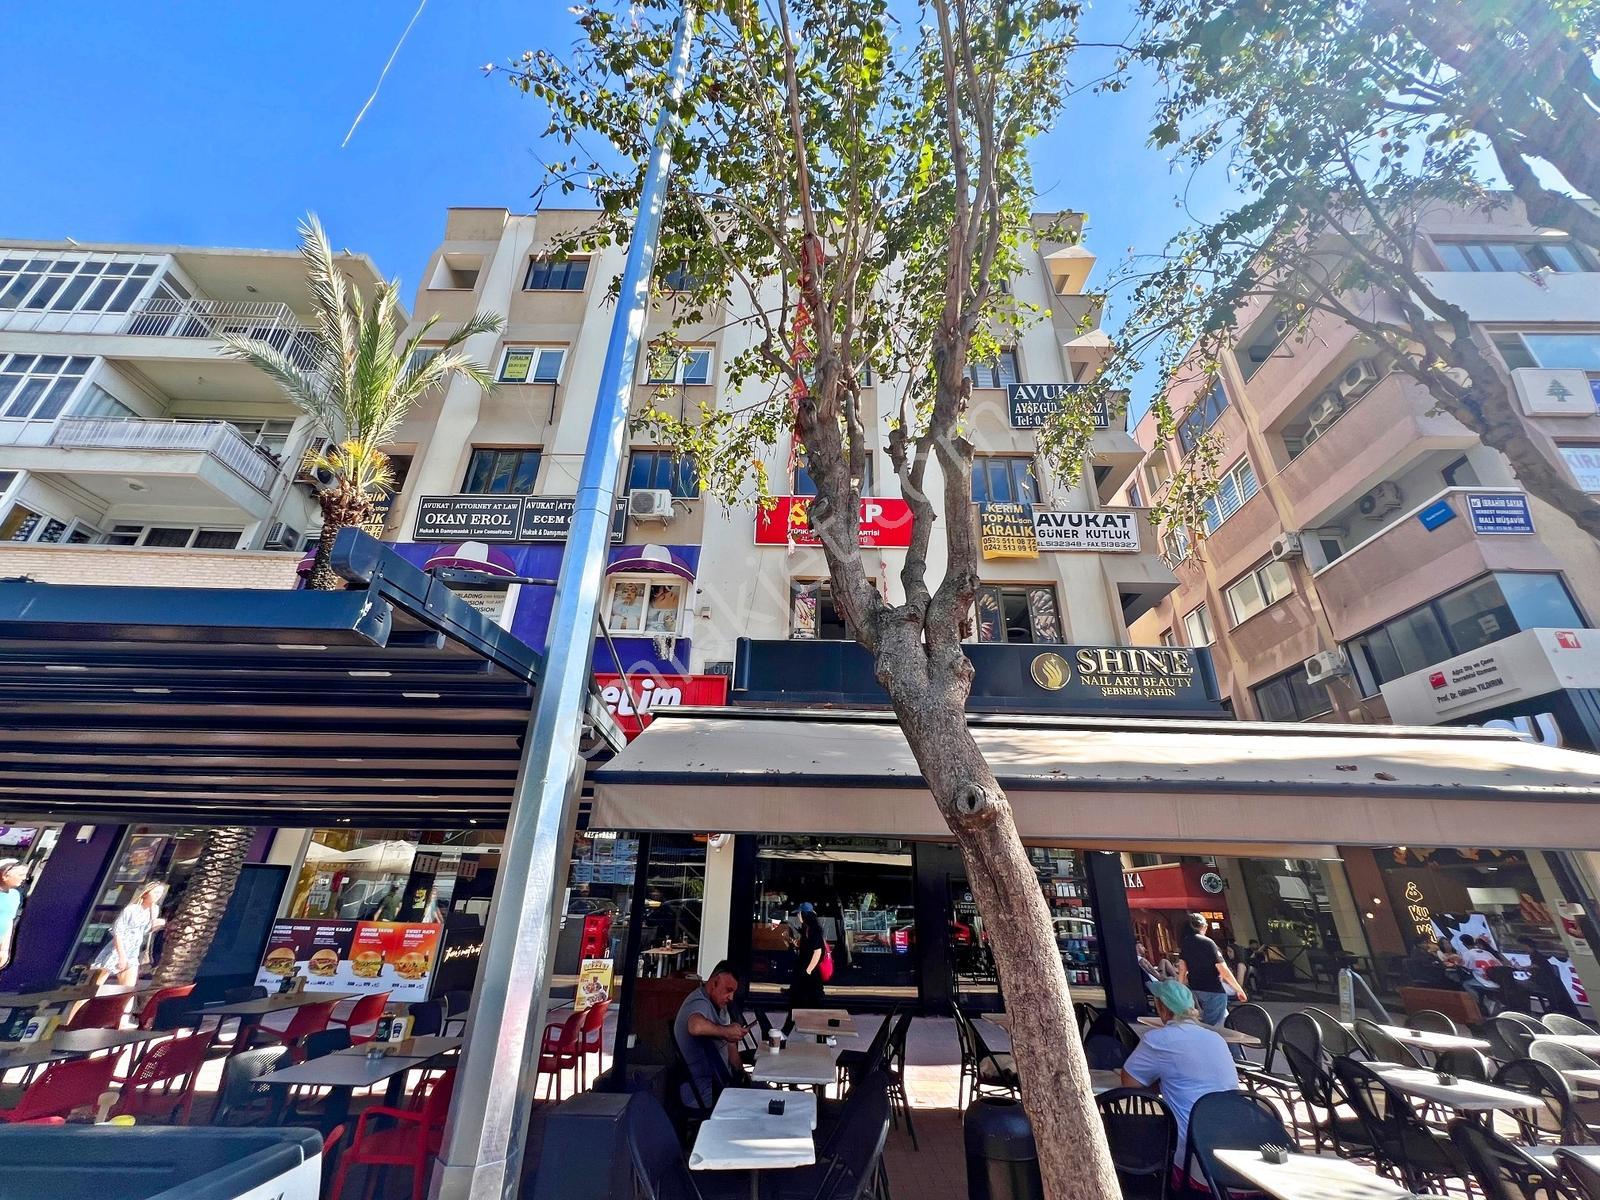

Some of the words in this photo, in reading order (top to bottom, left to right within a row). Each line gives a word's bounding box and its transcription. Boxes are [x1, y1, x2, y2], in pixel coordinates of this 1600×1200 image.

[526, 502, 556, 510] AVUKAT
[425, 513, 466, 525] OKAN
[470, 514, 512, 526] EROL
[533, 516, 565, 524] ECEM
[1036, 514, 1130, 528] AVUKAT
[982, 523, 1034, 536] KİRALIK
[1038, 529, 1079, 539] GÜNER
[1086, 530, 1131, 540] KUTLUK
[1076, 649, 1194, 676] SHINE
[1080, 676, 1112, 686] NAIL
[1115, 676, 1138, 686] ART
[1142, 678, 1192, 688] BEAUTY
[1101, 687, 1142, 696] ŞEBNEM
[1144, 687, 1176, 698] ŞAHİN
